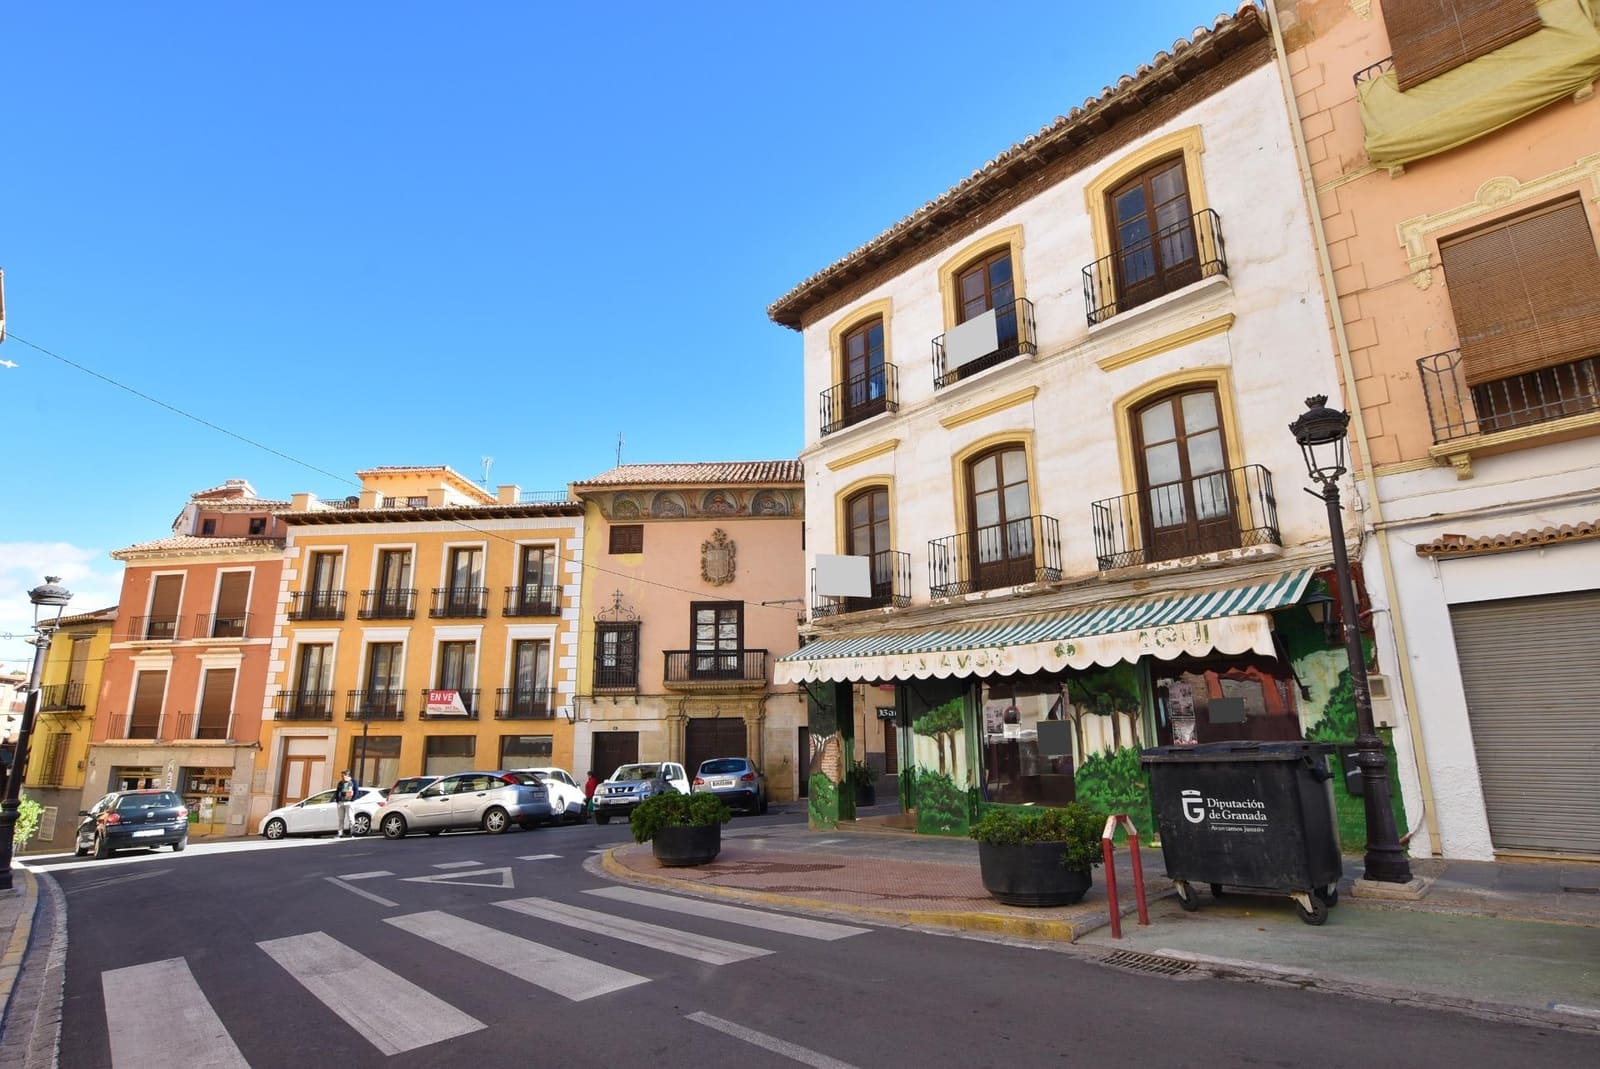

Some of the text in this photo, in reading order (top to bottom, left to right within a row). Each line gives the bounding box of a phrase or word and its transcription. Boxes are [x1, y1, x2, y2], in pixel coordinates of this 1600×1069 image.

[430, 692, 441, 702] EN
[1206, 798, 1265, 810] Diputación
[1208, 809, 1268, 821] de Granada
